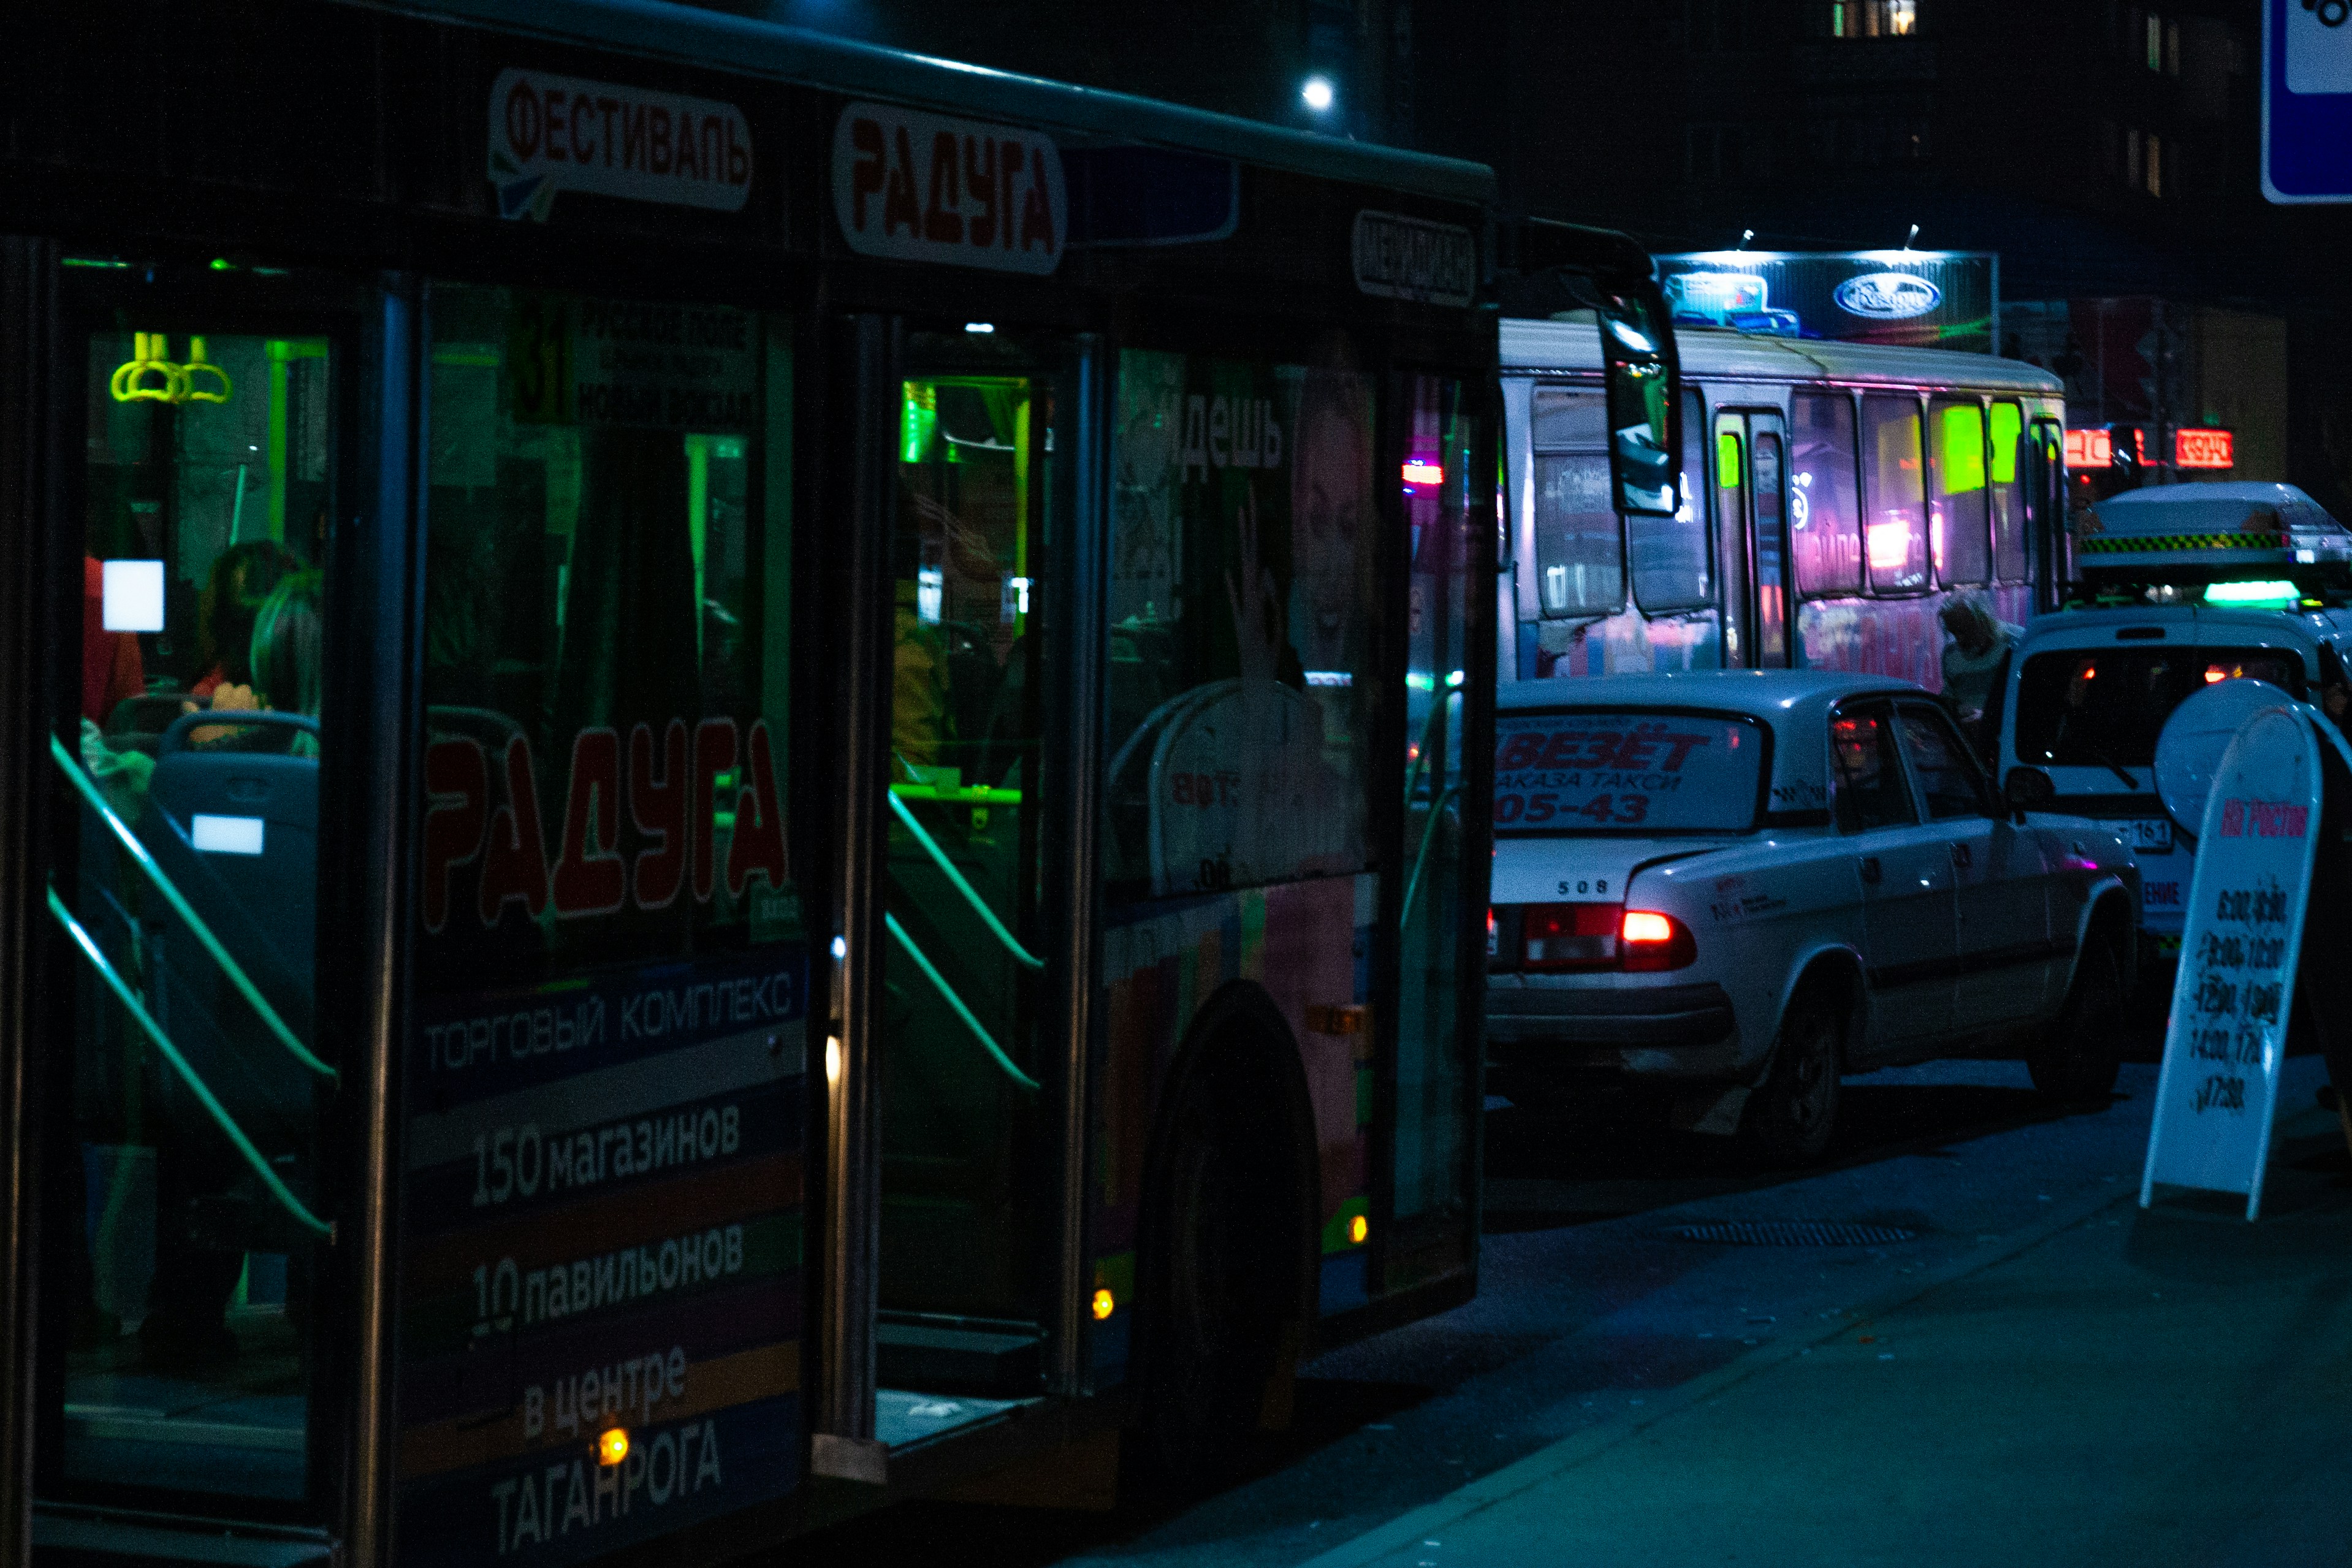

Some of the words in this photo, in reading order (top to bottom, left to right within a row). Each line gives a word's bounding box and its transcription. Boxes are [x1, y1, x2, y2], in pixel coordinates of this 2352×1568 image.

[506, 80, 753, 186] ФЕСТИВАЛЬ
[852, 118, 1055, 254] РАДУГА
[424, 717, 789, 934] РАДУГА
[1593, 774, 1683, 791] ТАКСИ
[425, 993, 607, 1070] ТОРГОВЫЙ
[620, 972, 793, 1040] КОМПЛЕКС
[471, 1121, 543, 1208] 150
[546, 1105, 742, 1190] магазинов
[471, 1257, 520, 1339] 10
[524, 1223, 745, 1325] павильонов
[523, 1385, 544, 1441] в
[554, 1344, 687, 1439] центре
[492, 1420, 721, 1555] ТАГАНРОГА
